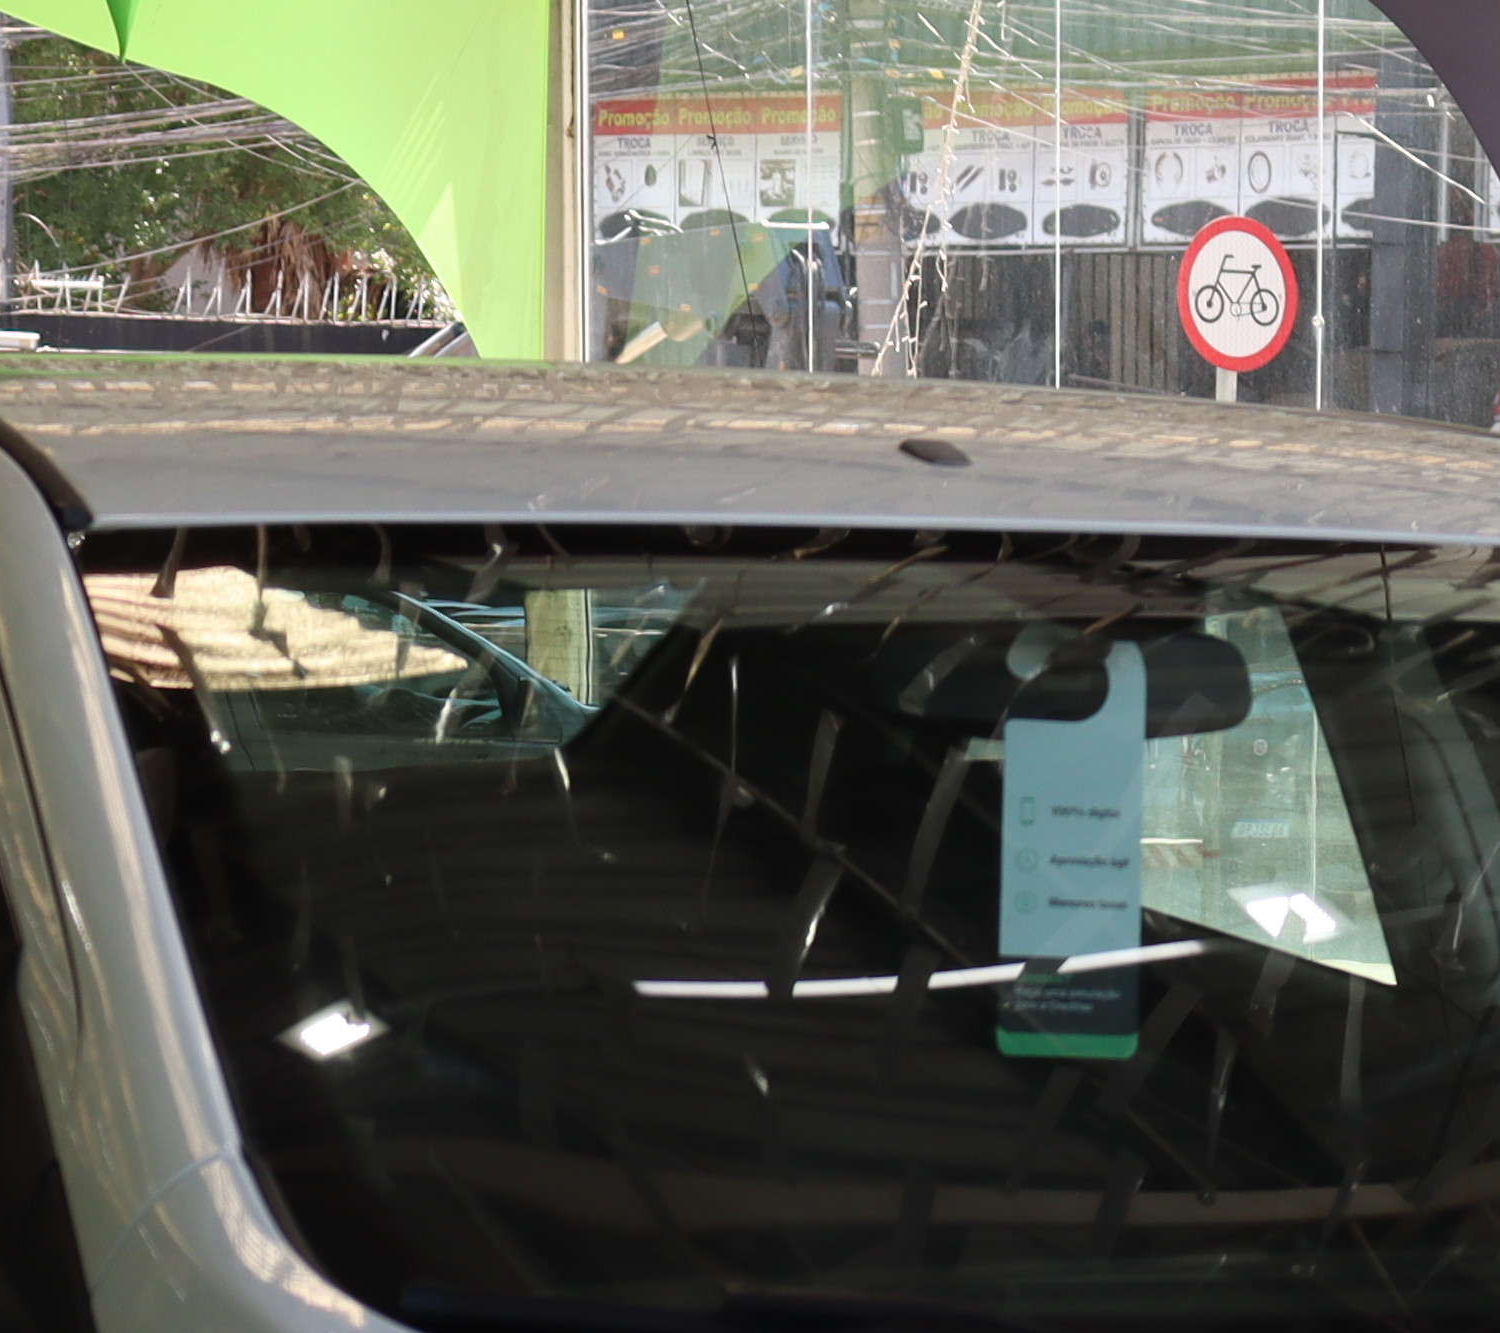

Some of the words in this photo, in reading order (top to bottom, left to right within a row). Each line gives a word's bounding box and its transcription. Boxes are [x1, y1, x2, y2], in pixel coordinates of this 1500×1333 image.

[598, 107, 670, 129] Promoção
[678, 106, 751, 129] Promoção
[1173, 122, 1213, 136] TROCA
[1269, 119, 1309, 133] TROCA
[617, 136, 651, 150] TROCA
